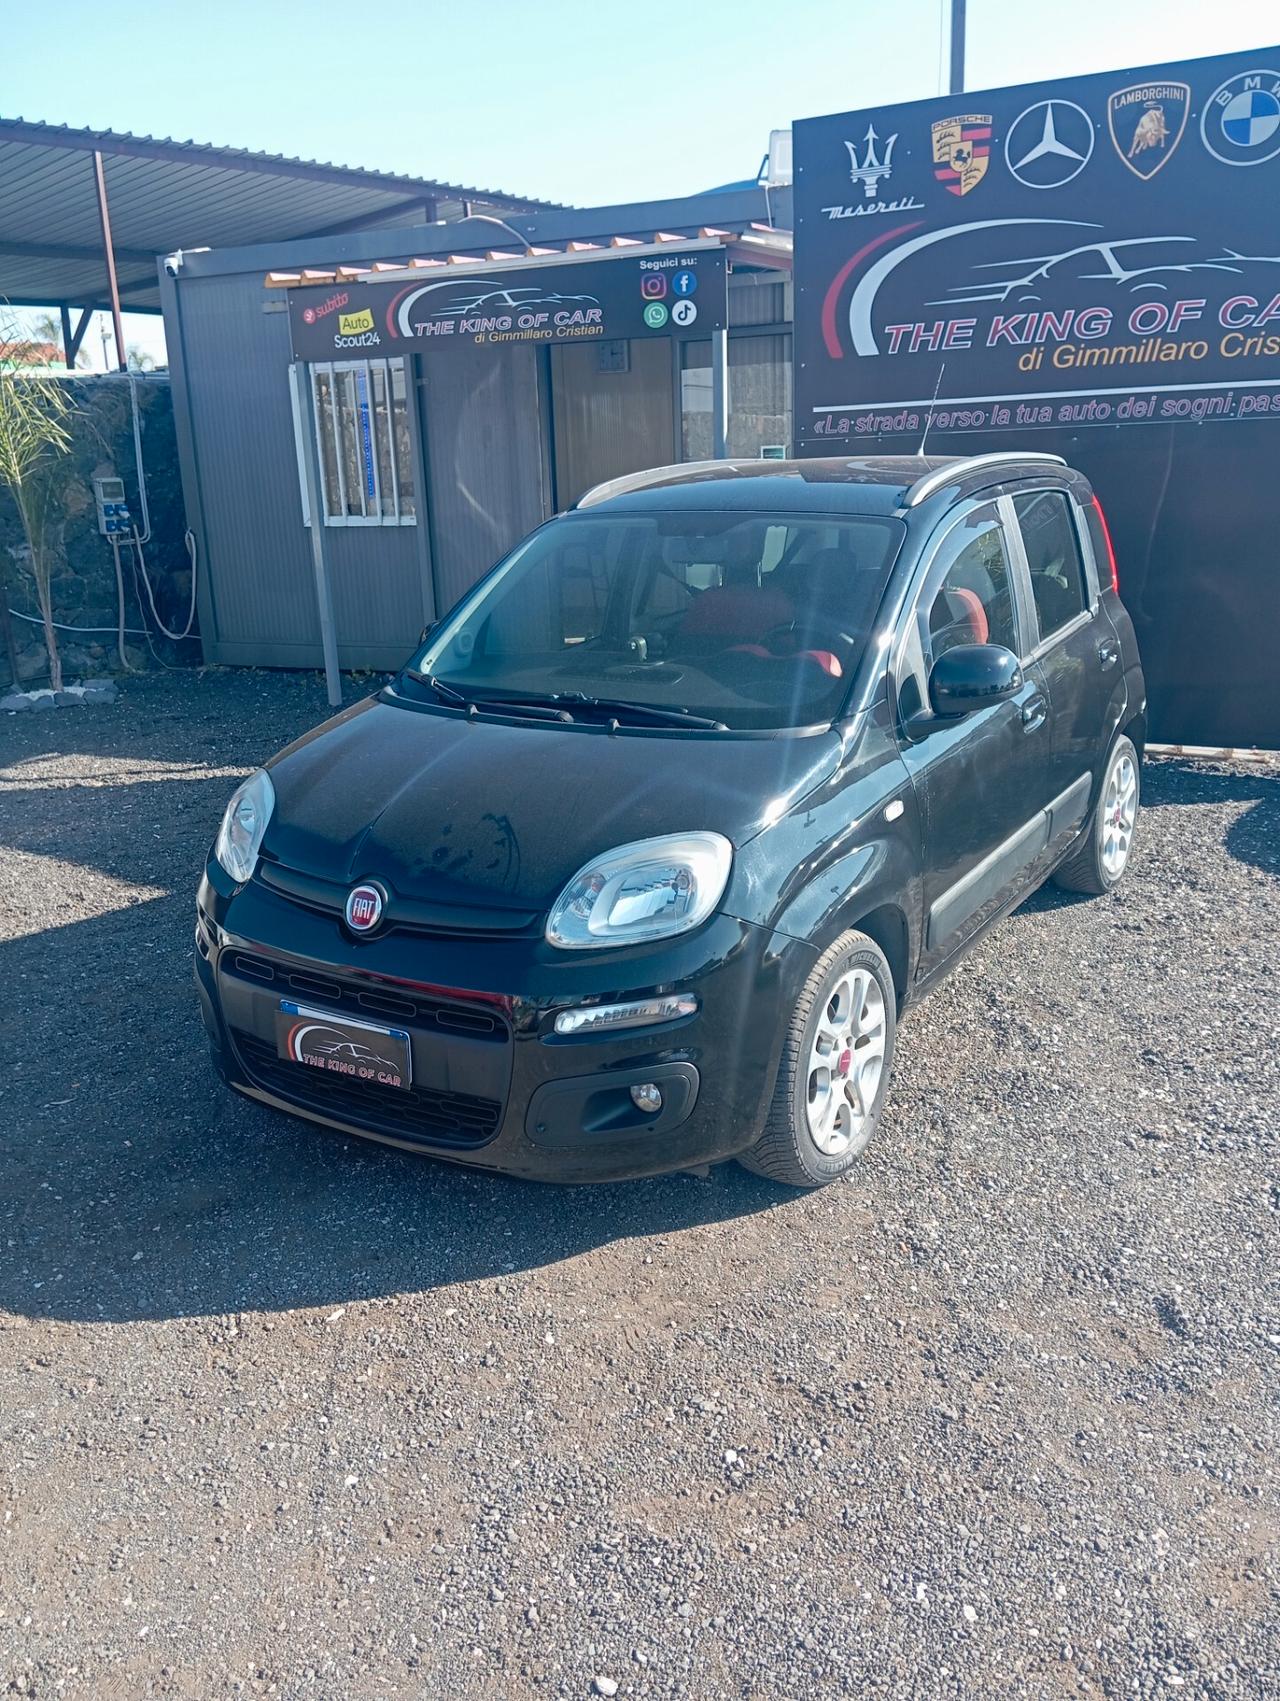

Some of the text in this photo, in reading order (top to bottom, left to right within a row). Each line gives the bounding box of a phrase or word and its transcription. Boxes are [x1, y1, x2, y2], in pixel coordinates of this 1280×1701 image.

[1114, 87, 1184, 109] LAMBORGHINI
[932, 115, 991, 131] PORSCHE
[640, 257, 698, 270] Seguici su:
[316, 292, 349, 317] subito
[342, 317, 370, 330] Auto
[414, 308, 602, 337] THE KING OF CAR
[474, 323, 603, 343] di Gimmillaro Cristian
[884, 318, 977, 355] THE
[986, 306, 1114, 347] KING
[1128, 299, 1207, 335] OF
[334, 332, 381, 348] Scout24
[1018, 346, 1045, 371] di
[1053, 337, 1208, 369] Gimmillaro
[855, 410, 919, 433] strada
[924, 410, 985, 430] verso
[990, 405, 1010, 425] la
[1016, 404, 1052, 424] tua
[1058, 400, 1111, 422] auto
[1117, 395, 1157, 418] dei
[1160, 391, 1233, 420] sogni
[353, 898, 375, 919] FIAT
[303, 1053, 401, 1087] THE KING OF CAR
